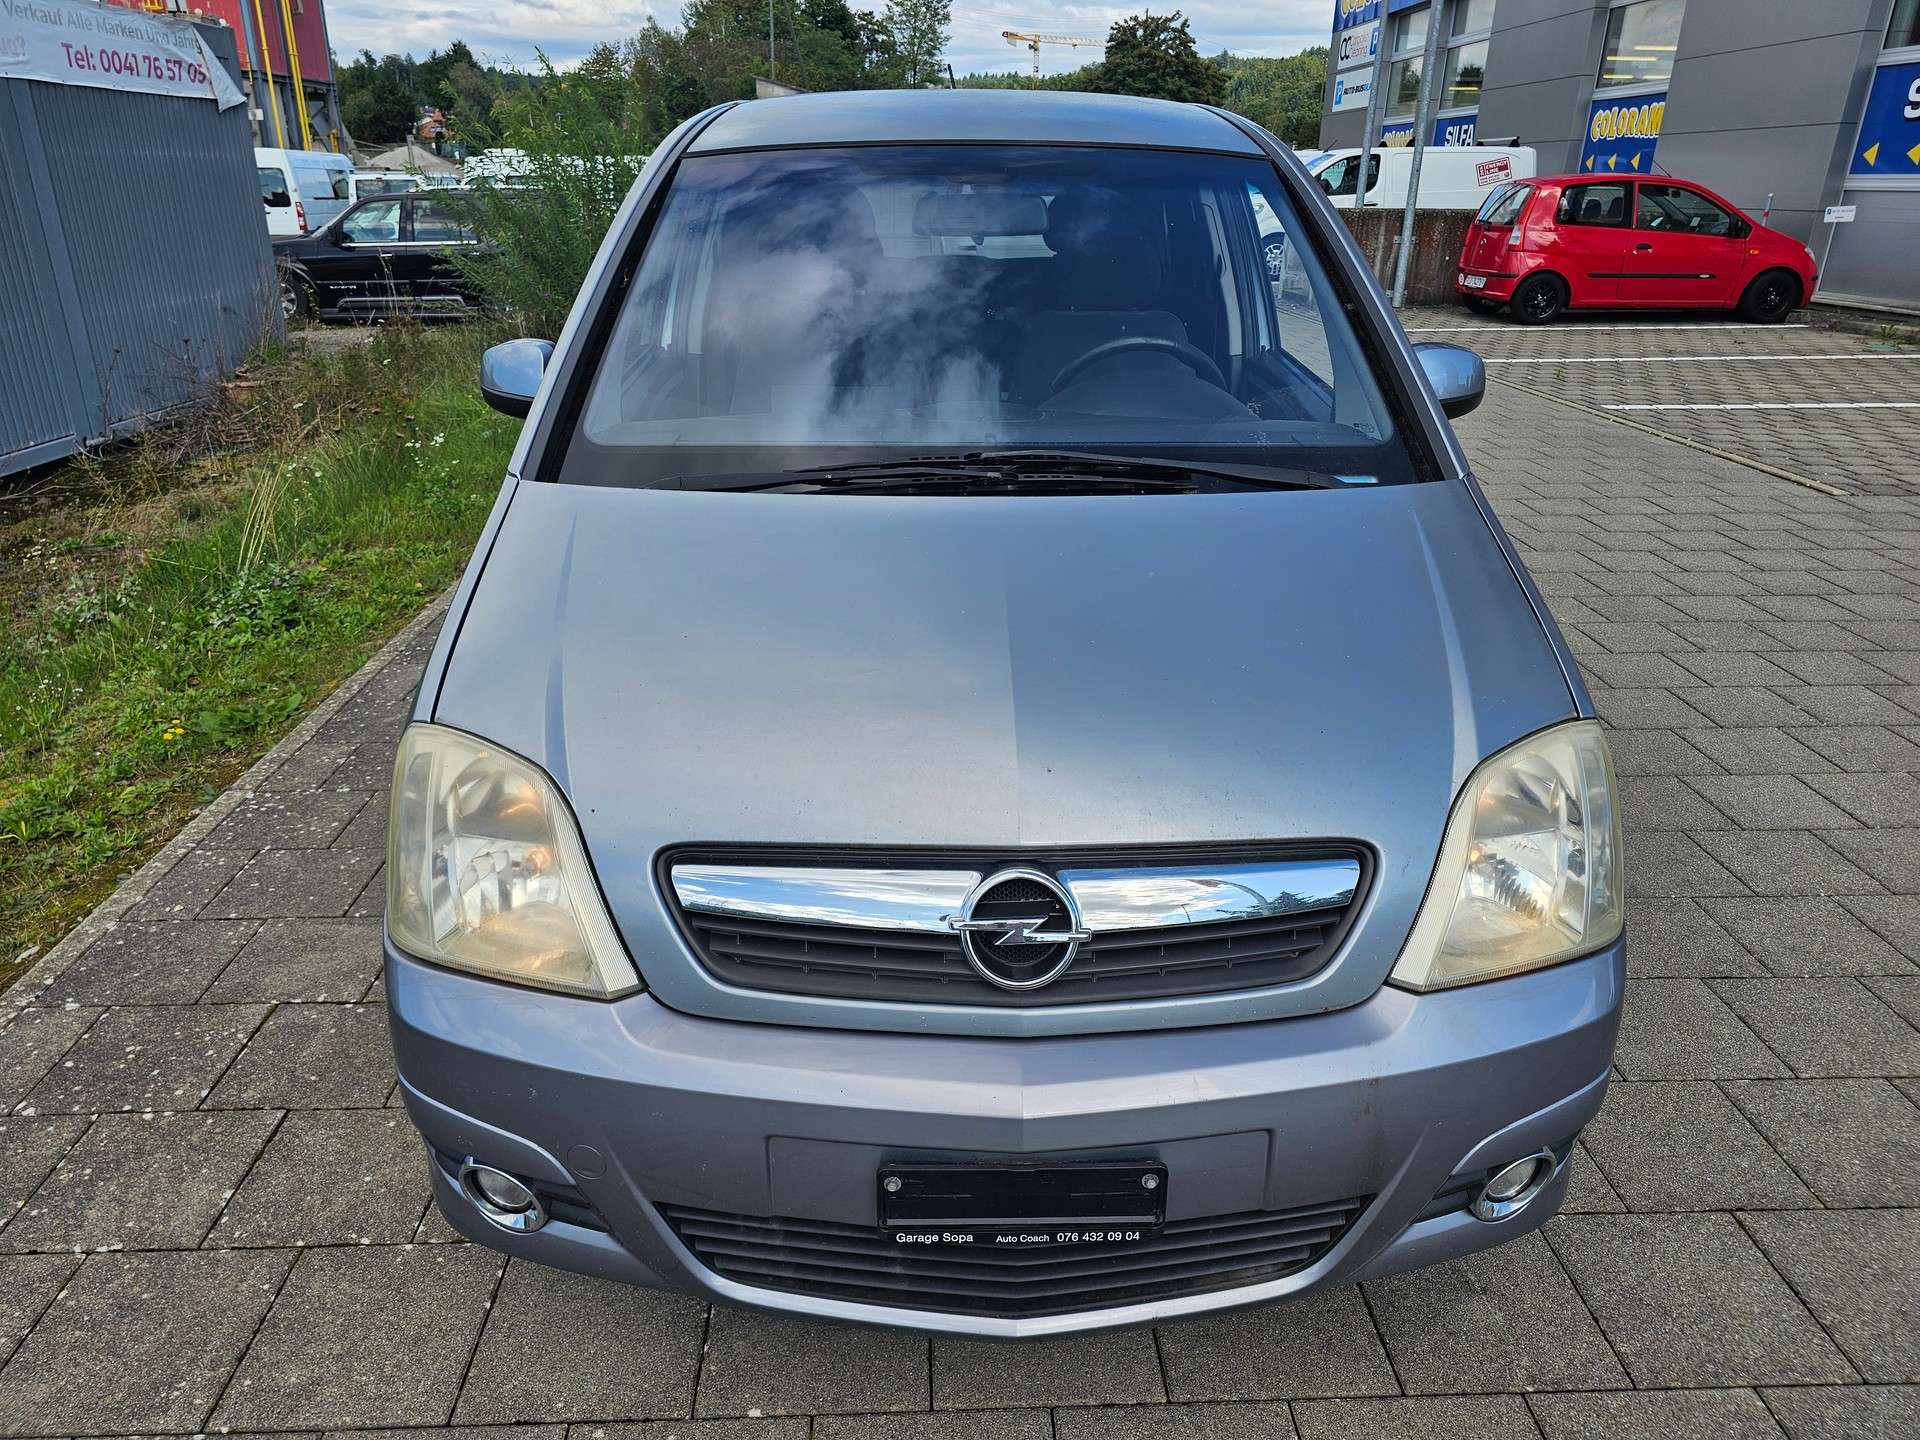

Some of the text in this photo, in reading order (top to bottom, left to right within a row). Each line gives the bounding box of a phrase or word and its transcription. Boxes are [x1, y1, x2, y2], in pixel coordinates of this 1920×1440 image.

[2, 0, 62, 26] Verkauf
[67, 11, 93, 31] Alle
[95, 16, 143, 40] Marken
[61, 42, 207, 84] Tel: 0041 76 57 05
[1444, 124, 1474, 147] SILFA
[1590, 102, 1666, 142] COLORAM
[896, 1231, 1140, 1244] Garage Sopa Auto Coach 076 432 09 04
